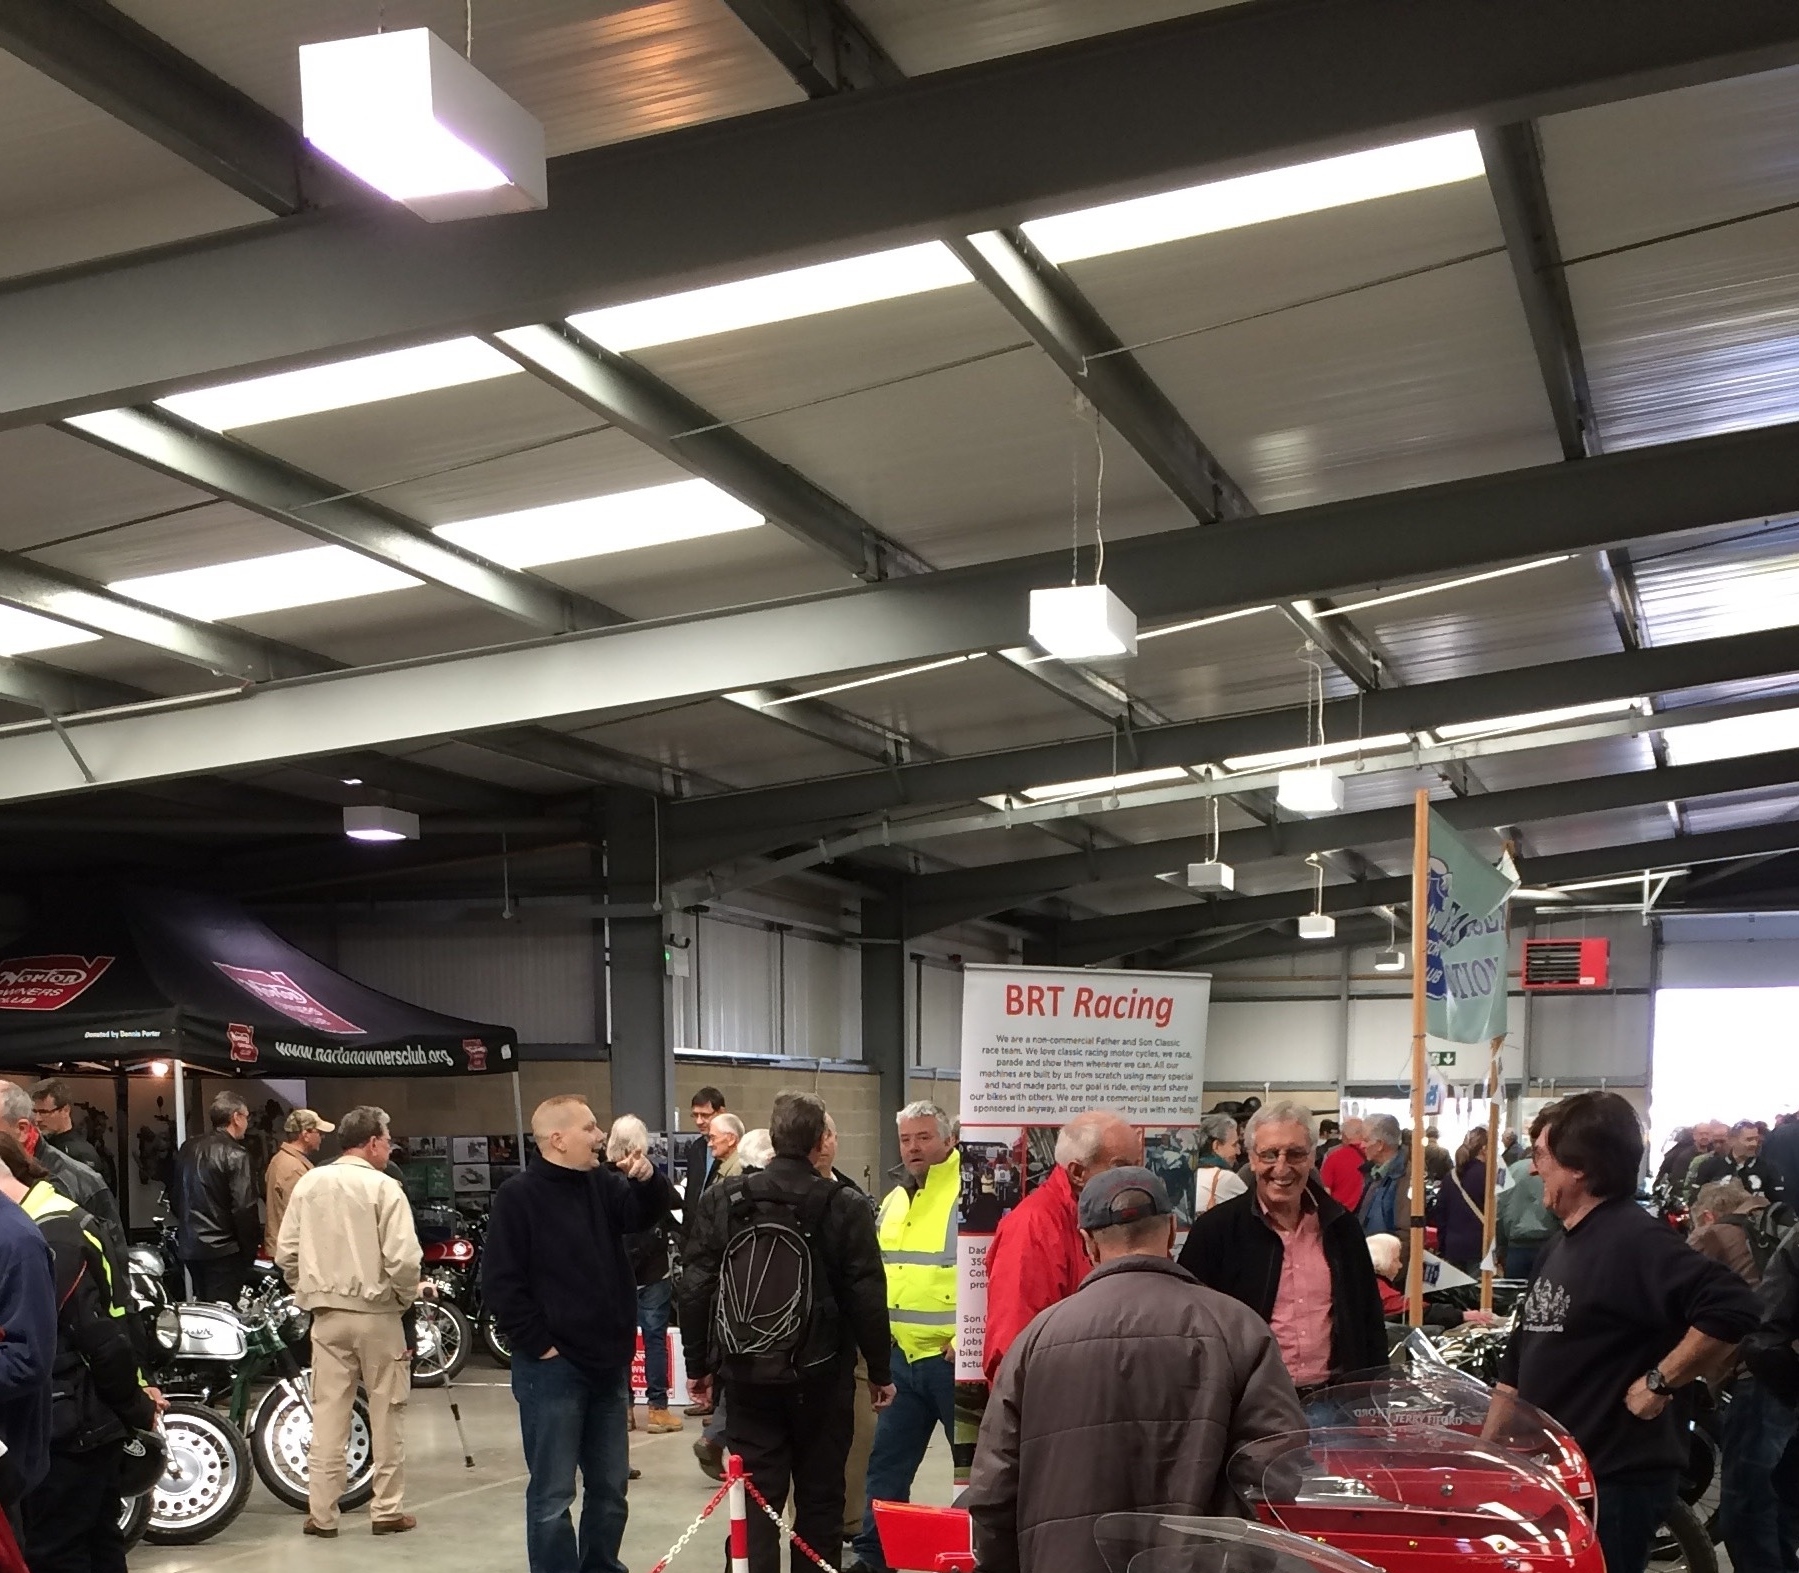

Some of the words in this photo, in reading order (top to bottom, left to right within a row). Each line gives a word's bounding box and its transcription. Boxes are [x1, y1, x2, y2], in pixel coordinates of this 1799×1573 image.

[0, 968, 87, 986] Norton
[1005, 984, 1065, 1017] BRT
[1073, 986, 1175, 1028] Racing
[110, 1030, 119, 1039] by
[997, 1035, 1008, 1043] We
[969, 1246, 986, 1254] Dad
[963, 1338, 982, 1346] jobs
